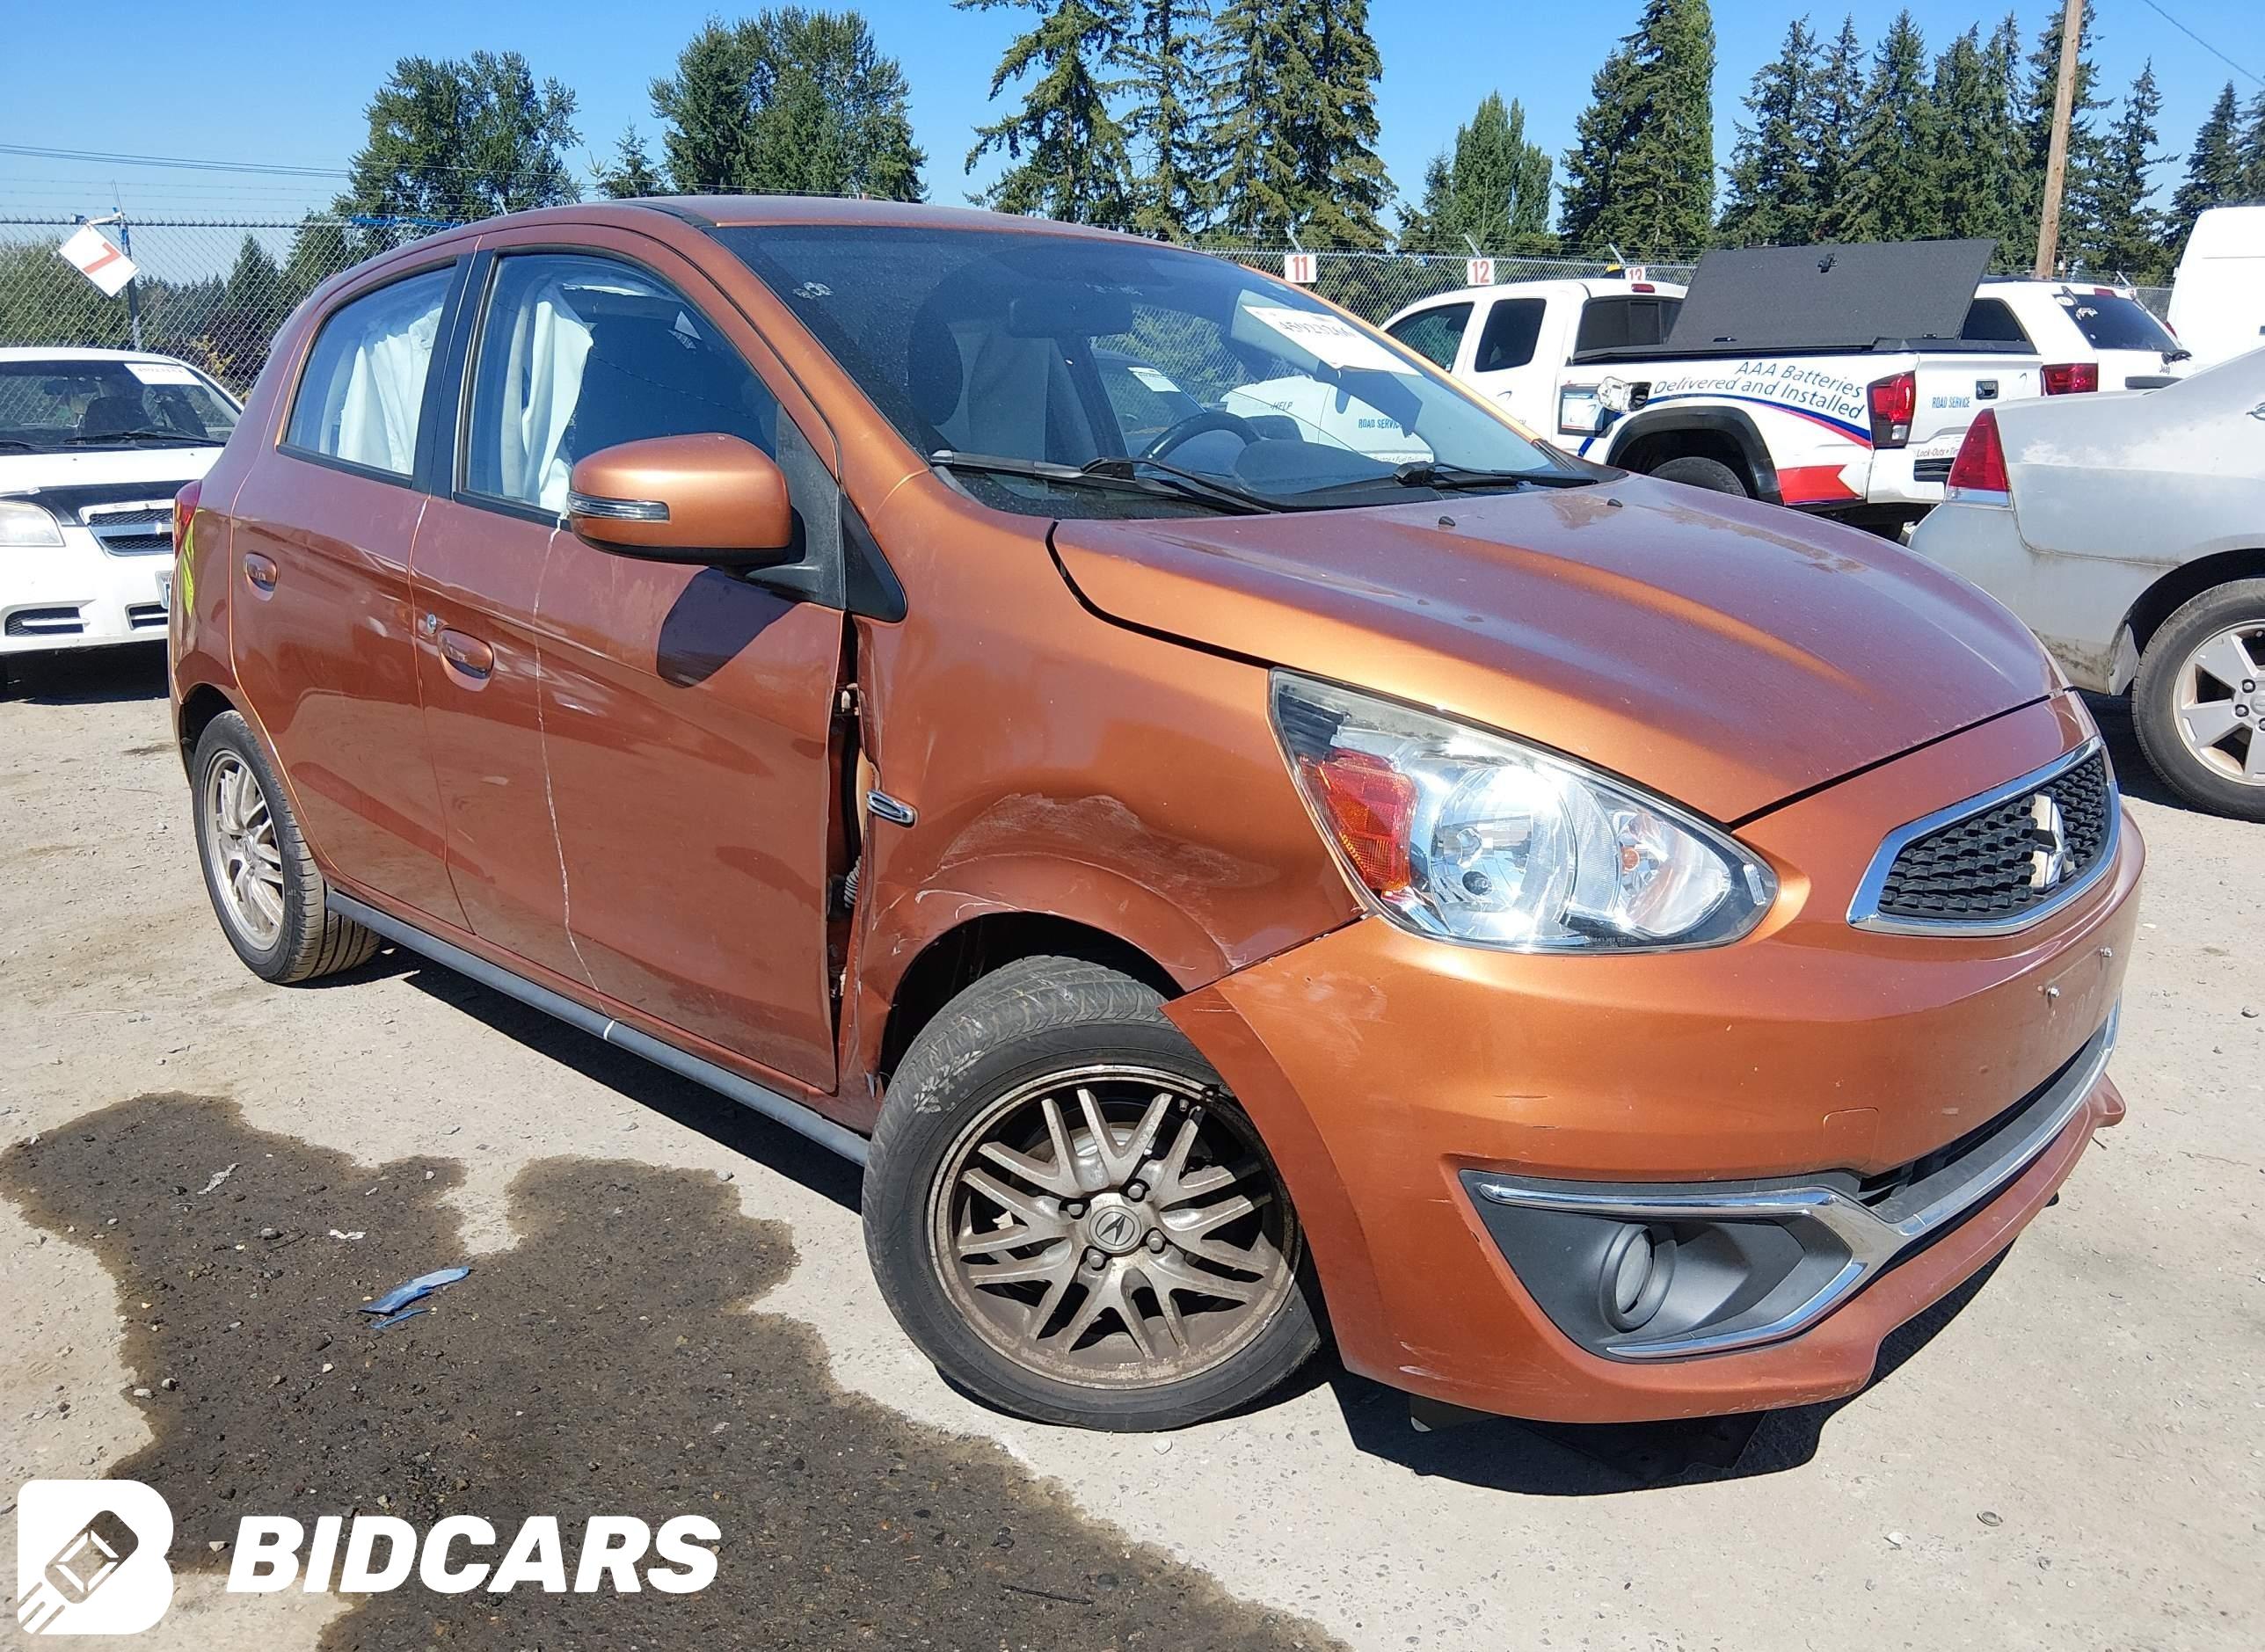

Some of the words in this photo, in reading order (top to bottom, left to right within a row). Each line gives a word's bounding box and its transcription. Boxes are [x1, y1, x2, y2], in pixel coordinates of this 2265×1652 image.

[82, 242, 121, 274] 7
[1293, 256, 1307, 281] 11
[1472, 260, 1489, 283] 12
[1734, 361, 1777, 376] AAA
[1781, 365, 1864, 398] Batteries
[1653, 376, 1742, 394] Delivered
[1741, 381, 1780, 396] and
[1781, 383, 1865, 419] Installed
[1932, 397, 1948, 408] ROAD
[1948, 396, 1970, 408] SERVICE
[1358, 418, 1375, 429] ROAD
